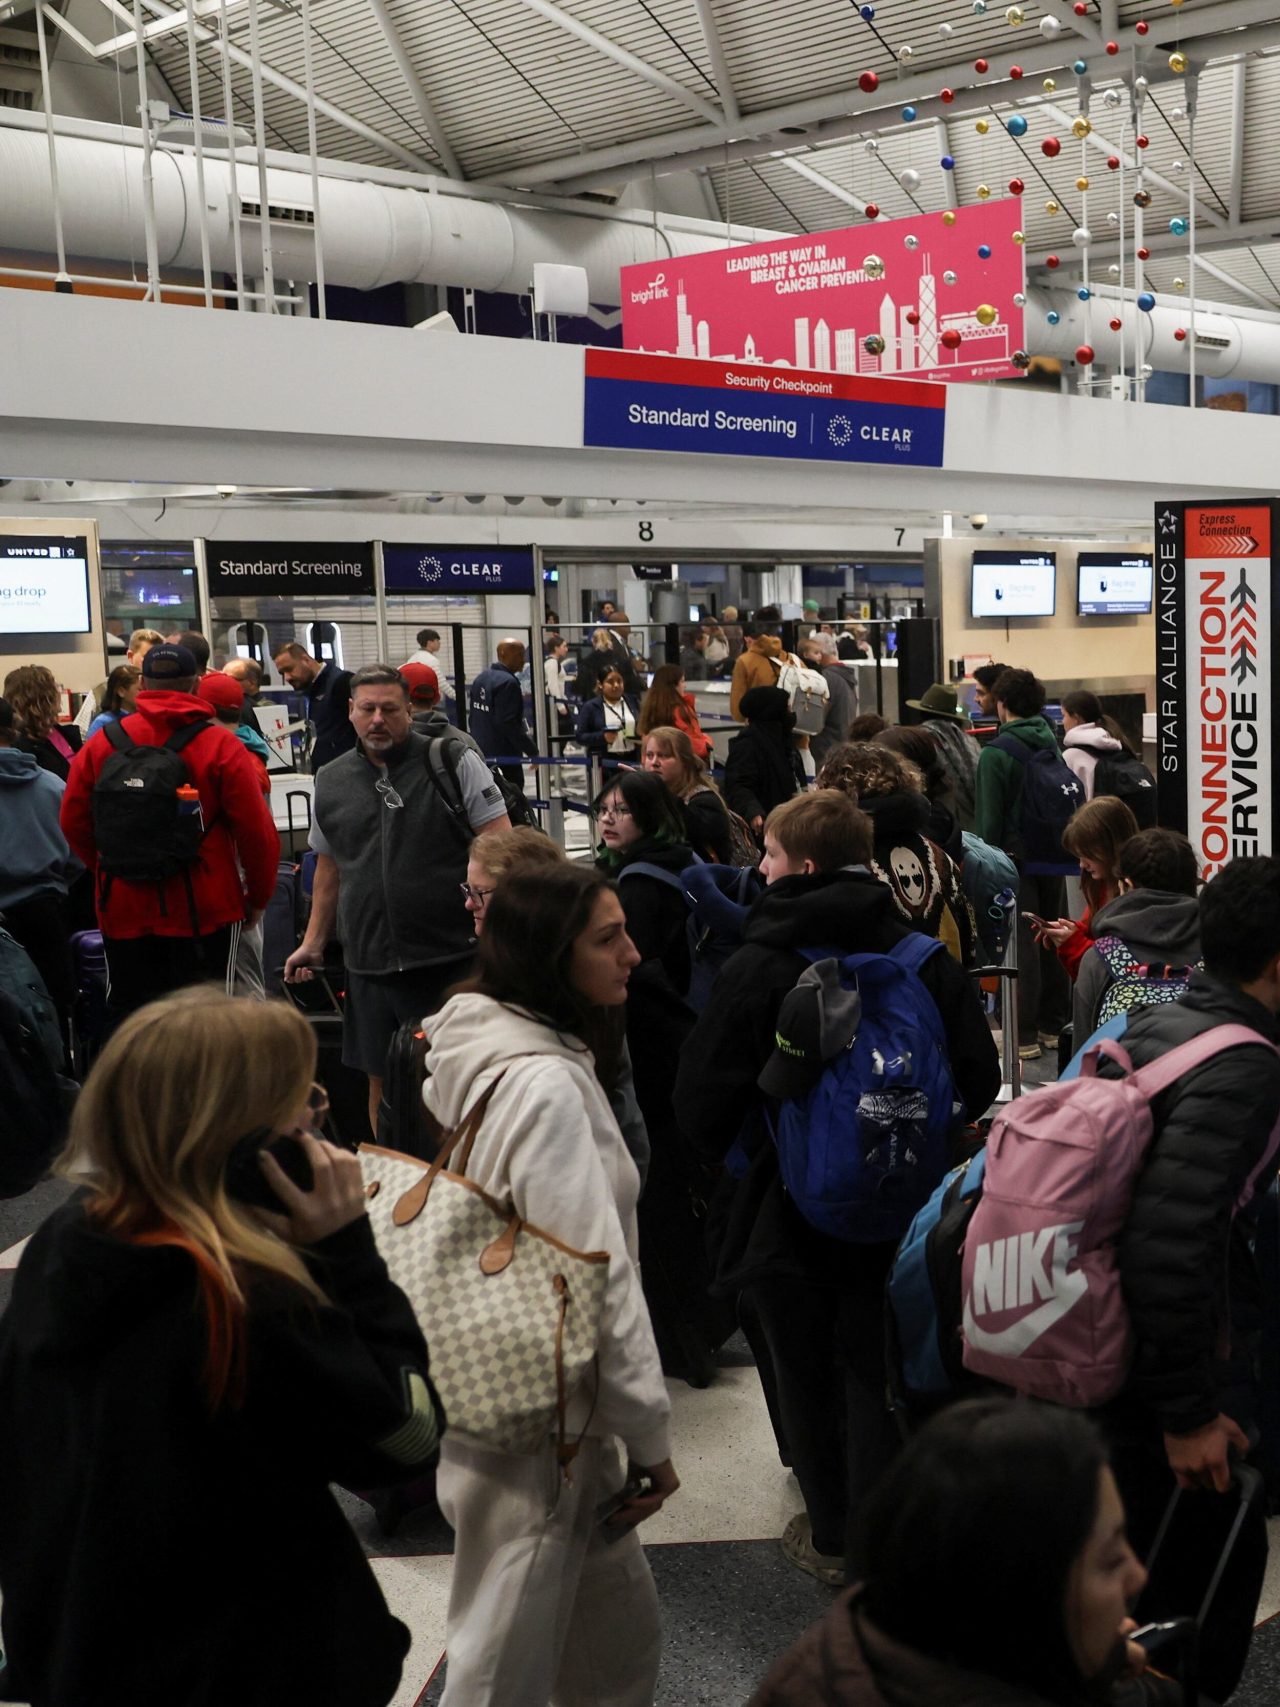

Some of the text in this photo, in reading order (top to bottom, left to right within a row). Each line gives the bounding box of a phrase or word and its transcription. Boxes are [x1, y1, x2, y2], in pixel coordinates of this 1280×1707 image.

[726, 244, 826, 274] LEADING THE WAY IN
[750, 256, 846, 284] BREAST & OVARIAN
[775, 278, 818, 294] CANCER
[631, 288, 654, 305] bright
[725, 372, 833, 395] Security Checkpoint
[628, 404, 797, 438] Standard Screening
[860, 425, 912, 444] CLEAR
[895, 443, 911, 452] PLUS
[1199, 514, 1236, 527] Express
[639, 520, 654, 541] 8
[894, 528, 905, 546] 7
[1199, 523, 1252, 537] Connection
[7, 548, 49, 556] UNITED
[219, 560, 363, 577] Standard Screening
[450, 563, 502, 576] CLEAR
[14, 586, 46, 599] drop
[1160, 543, 1178, 773] STAR ALLIANCE
[973, 1220, 1086, 1316] NIKE
